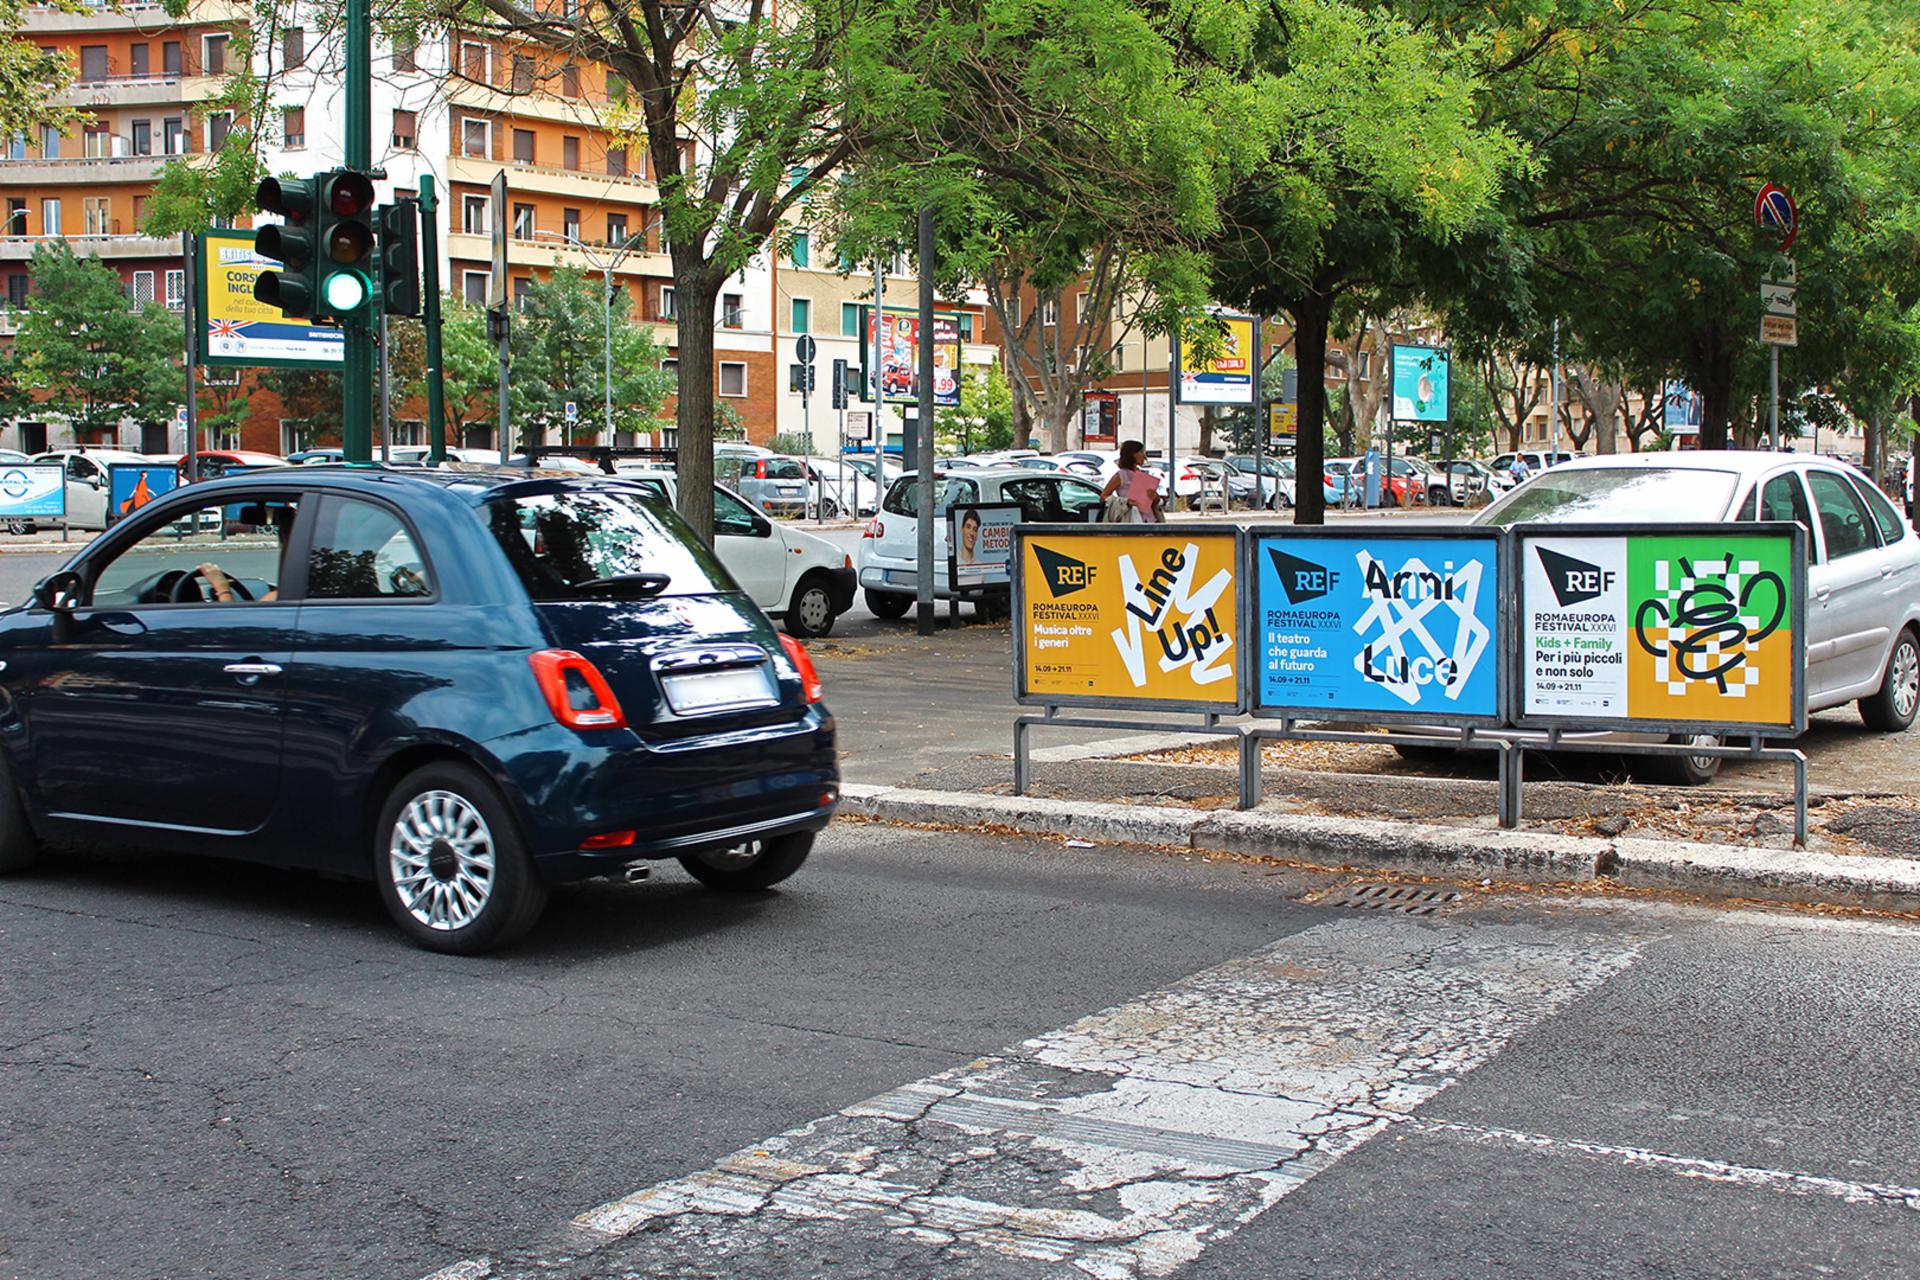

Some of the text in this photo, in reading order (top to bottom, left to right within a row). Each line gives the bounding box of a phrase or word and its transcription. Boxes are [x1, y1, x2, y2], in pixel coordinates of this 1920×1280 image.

[982, 527, 1009, 538] CAMBI
[982, 539, 1010, 549] METOD
[1057, 566, 1097, 585] REF
[1295, 571, 1340, 591] REF
[1566, 571, 1616, 592] REF
[1125, 547, 1187, 627] Line
[1033, 603, 1098, 612] ROMAEUROPA
[1033, 611, 1100, 621] FESTIVAL XXXVI
[1267, 610, 1341, 620] ROMAEUROPA
[1535, 613, 1616, 623] ROMAEUROPA
[1033, 623, 1093, 636] Musica oltre
[1267, 619, 1342, 629] FESTIVAL XXXVI
[1535, 622, 1617, 633] FESTIVAL XXXVI
[1157, 607, 1225, 662] Up!
[1268, 632, 1311, 645] Il teatro
[1033, 635, 1069, 650] i generi
[1535, 636, 1561, 648] Kids
[1573, 637, 1613, 652] Family
[1268, 646, 1328, 660] che guarda
[1535, 650, 1623, 666] Per i più piccoli
[1057, 665, 1073, 673] 21.11
[1268, 659, 1315, 672] al futuro
[1363, 643, 1458, 687] Luce
[1535, 666, 1594, 678] e non solo
[1268, 676, 1311, 684] 14.09 21.11
[1564, 683, 1582, 691] 21.11
